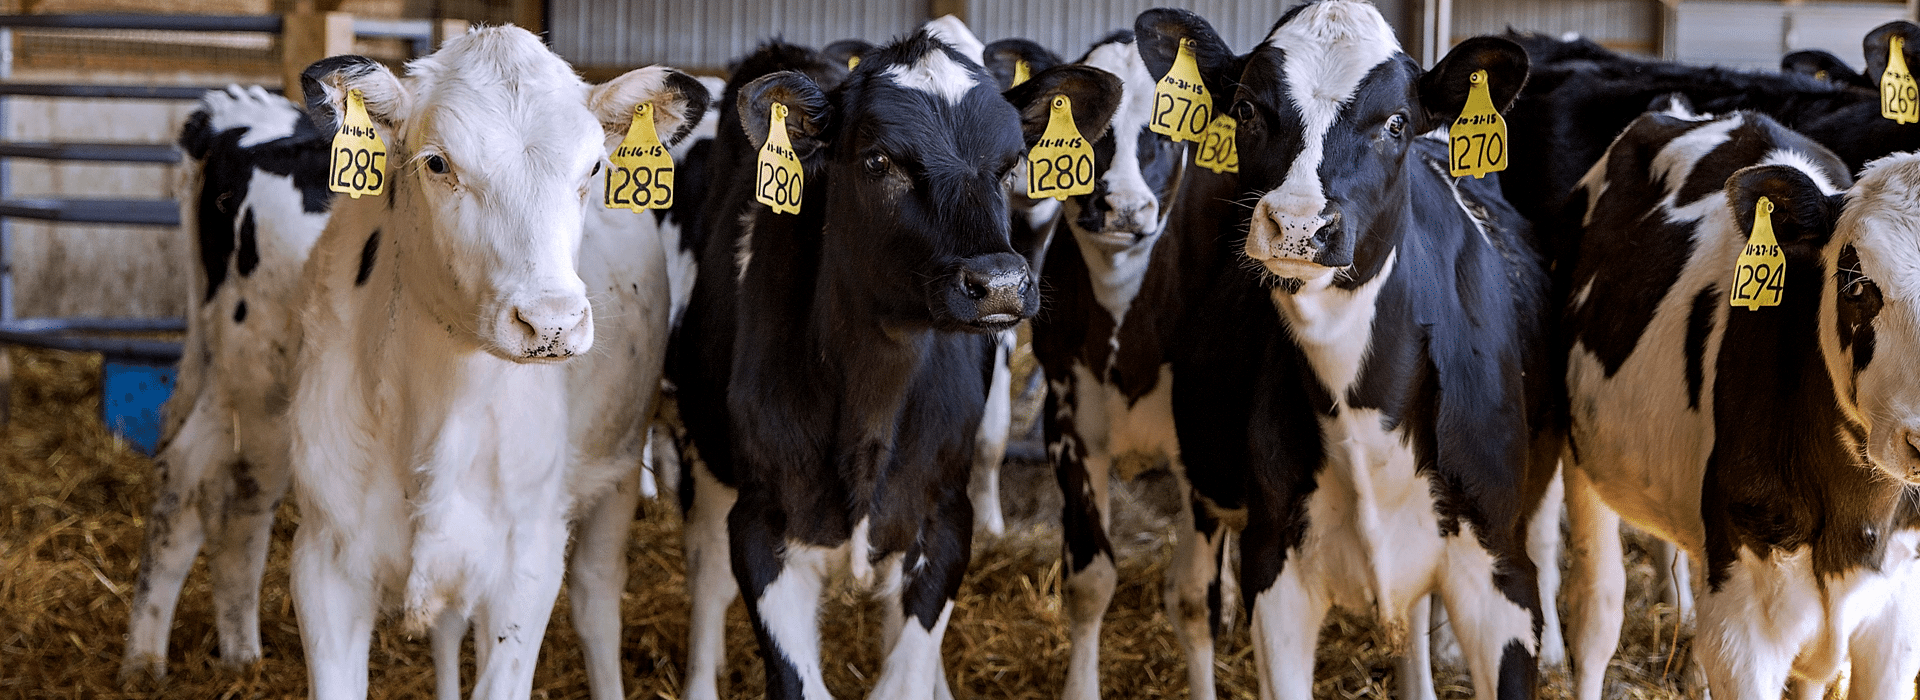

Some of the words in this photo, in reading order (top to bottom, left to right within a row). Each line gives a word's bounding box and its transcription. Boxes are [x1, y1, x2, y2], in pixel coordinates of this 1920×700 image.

[1152, 91, 1208, 134] 1270
[1883, 83, 1917, 115] 1269
[331, 147, 385, 190] 1285
[1451, 132, 1503, 171] 1270
[605, 166, 673, 206] 1285
[758, 161, 802, 206] 1280
[1030, 154, 1093, 193] 1280
[1733, 263, 1783, 303] 1294
